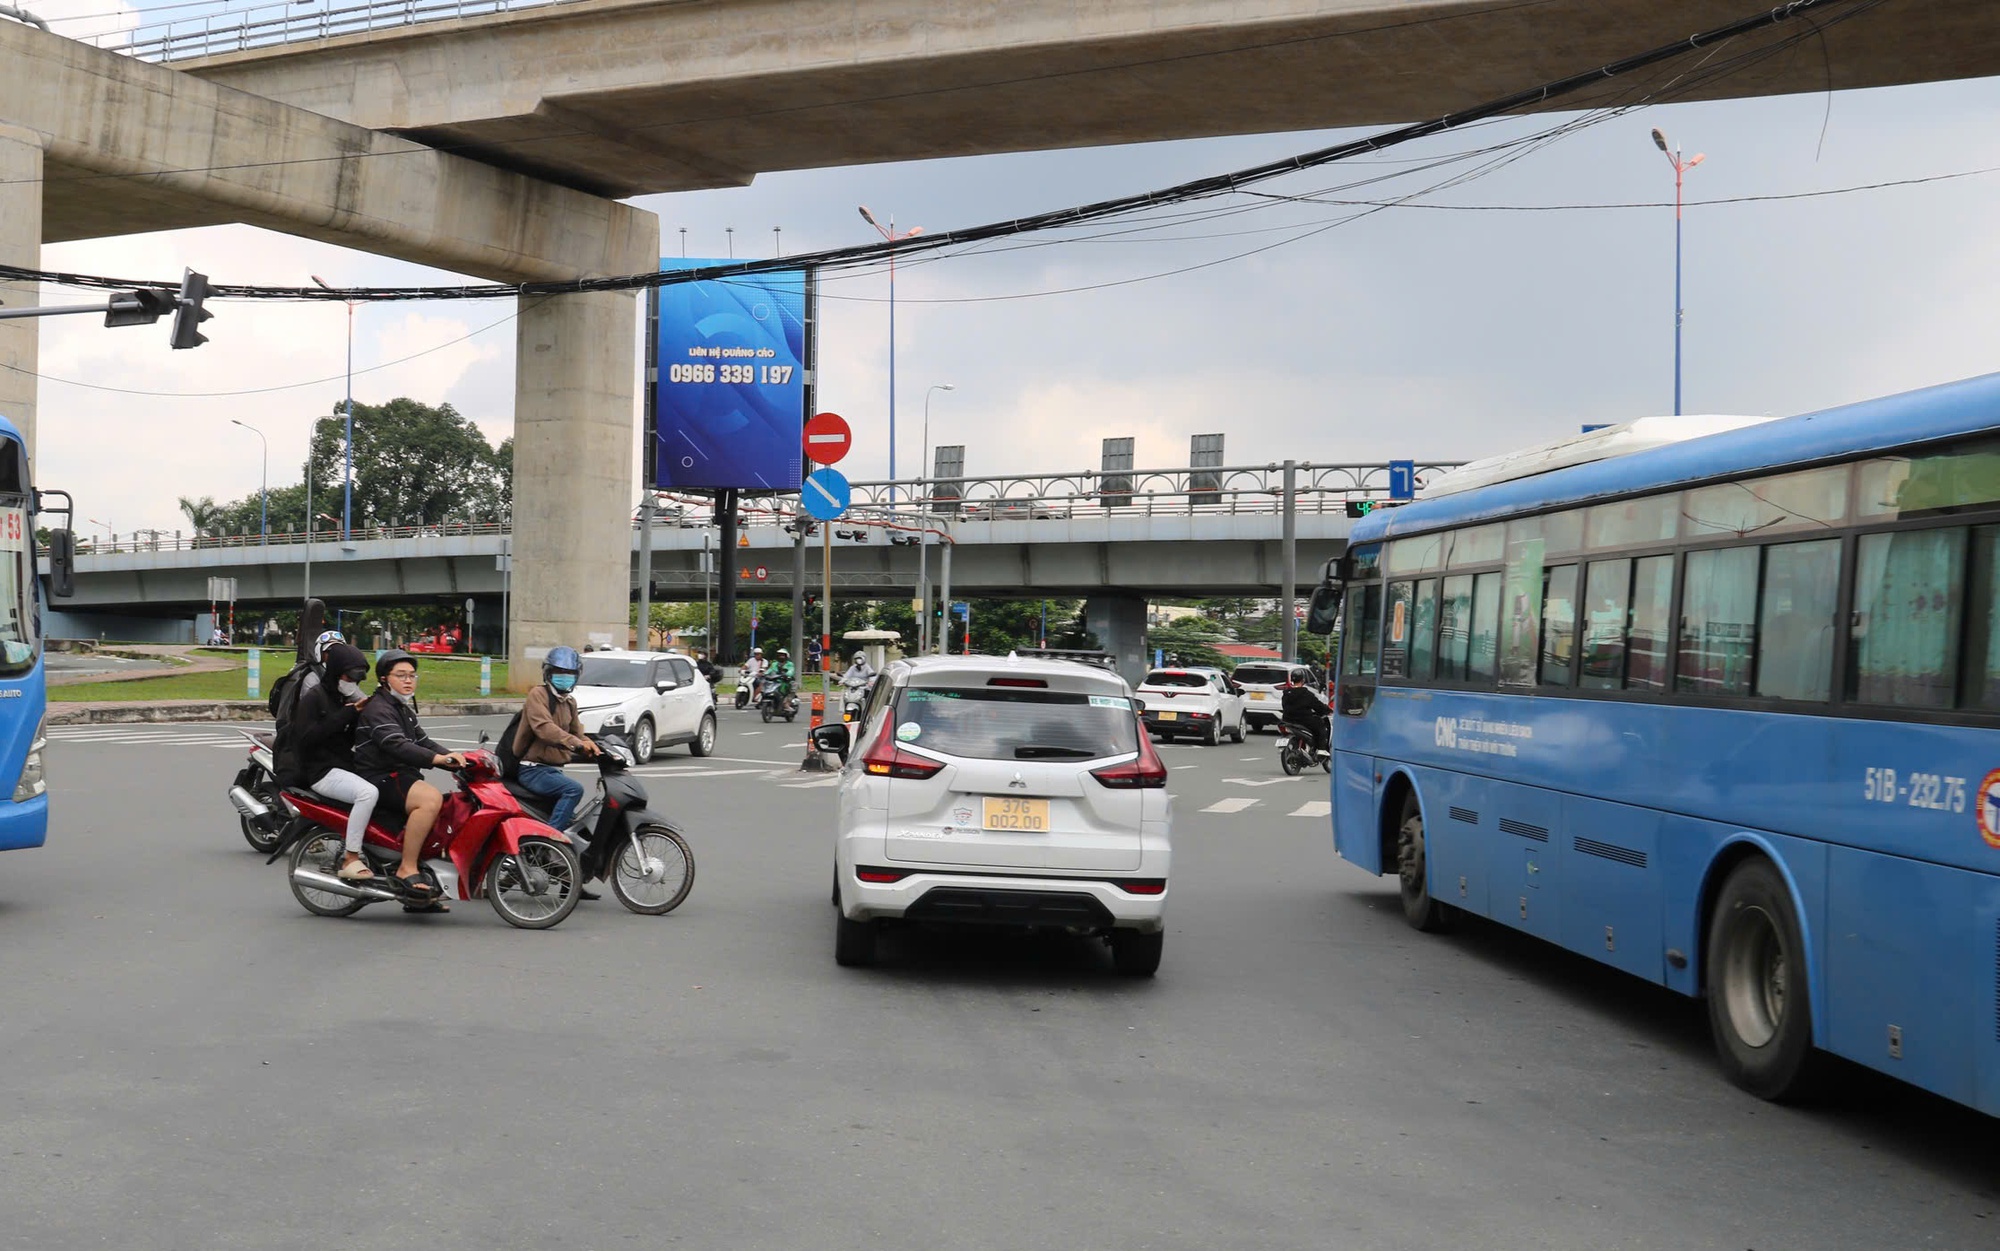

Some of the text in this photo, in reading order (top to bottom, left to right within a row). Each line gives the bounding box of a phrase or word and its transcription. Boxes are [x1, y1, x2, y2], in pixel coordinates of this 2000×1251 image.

[670, 363, 793, 384] 0966 339 197
[8, 513, 21, 540] 53
[1435, 716, 1457, 749] CNG
[1864, 767, 1896, 802] 51B
[1908, 772, 1966, 813] 232.75
[1002, 800, 1031, 814] 37G
[990, 814, 1042, 830] 002.00
